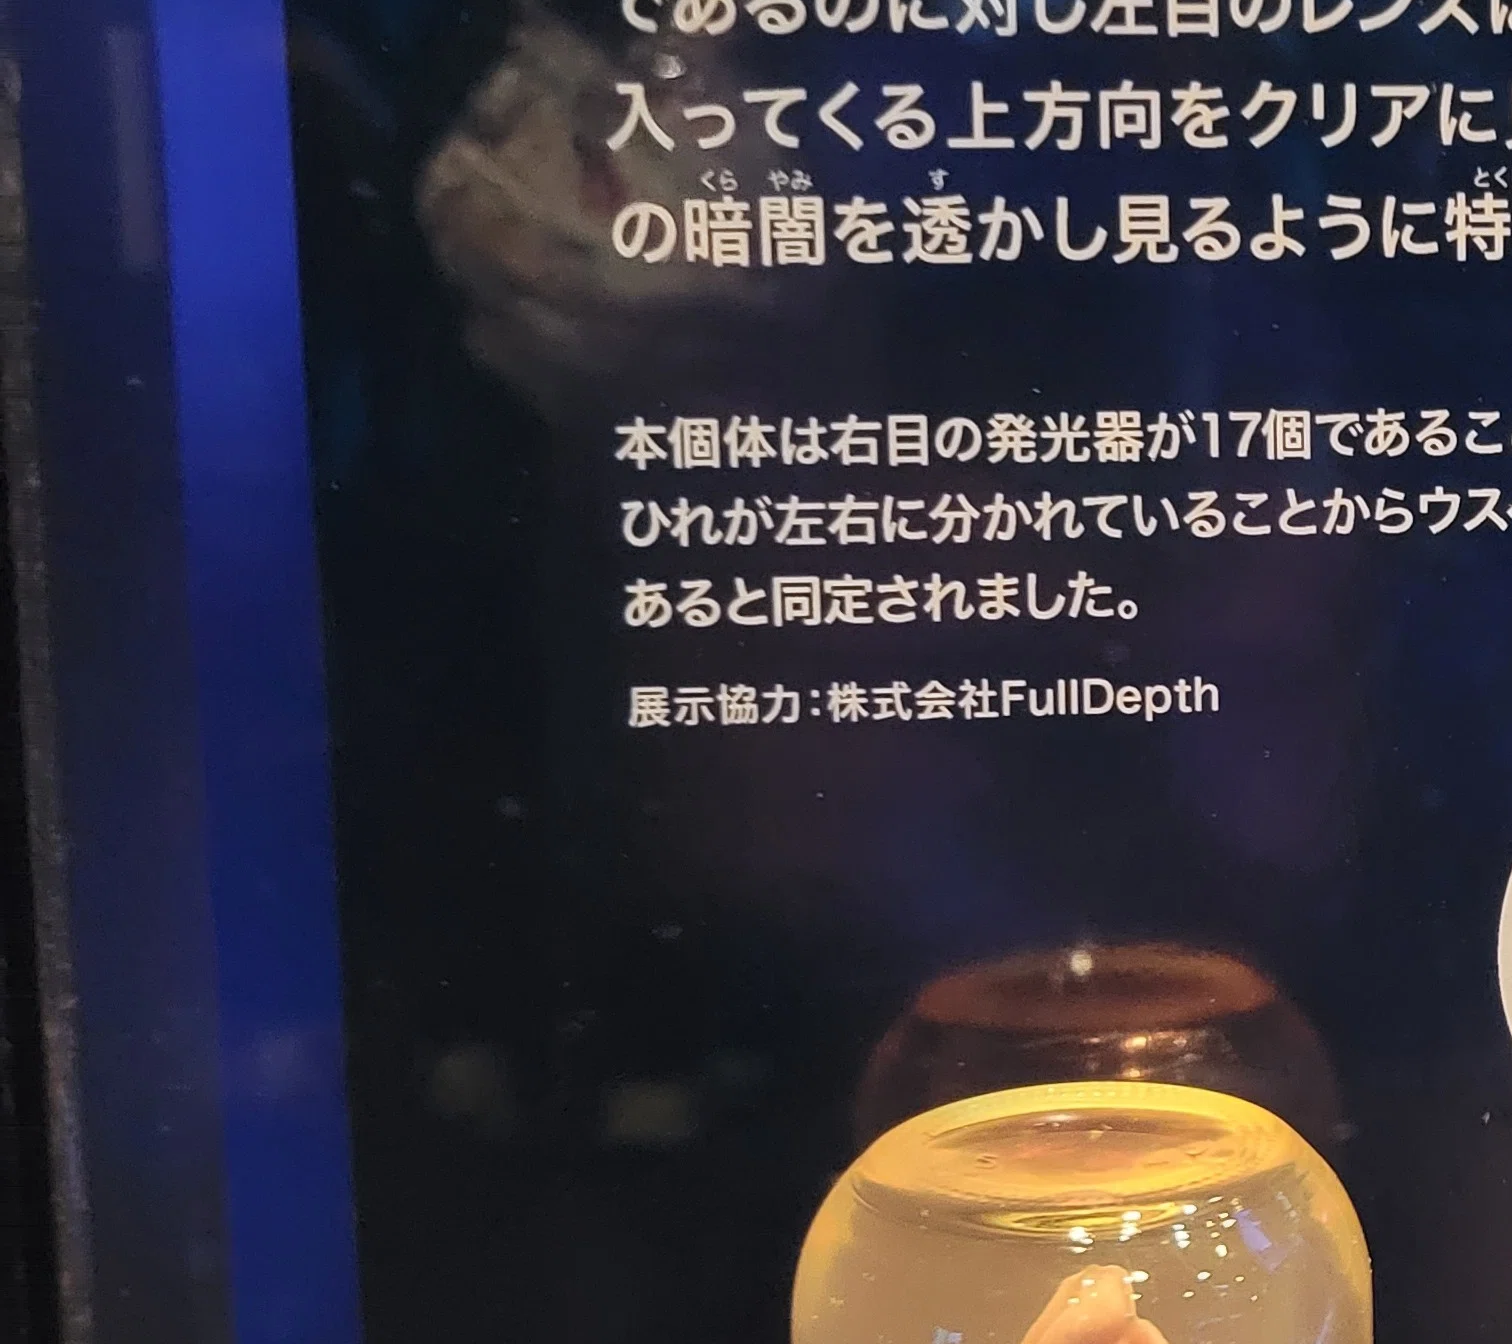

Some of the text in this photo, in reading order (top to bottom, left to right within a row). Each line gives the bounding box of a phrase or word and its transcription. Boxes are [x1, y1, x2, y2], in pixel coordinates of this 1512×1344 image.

[701, 168, 949, 192] くら やみ す
[623, 570, 1139, 628] あると同定されました。
